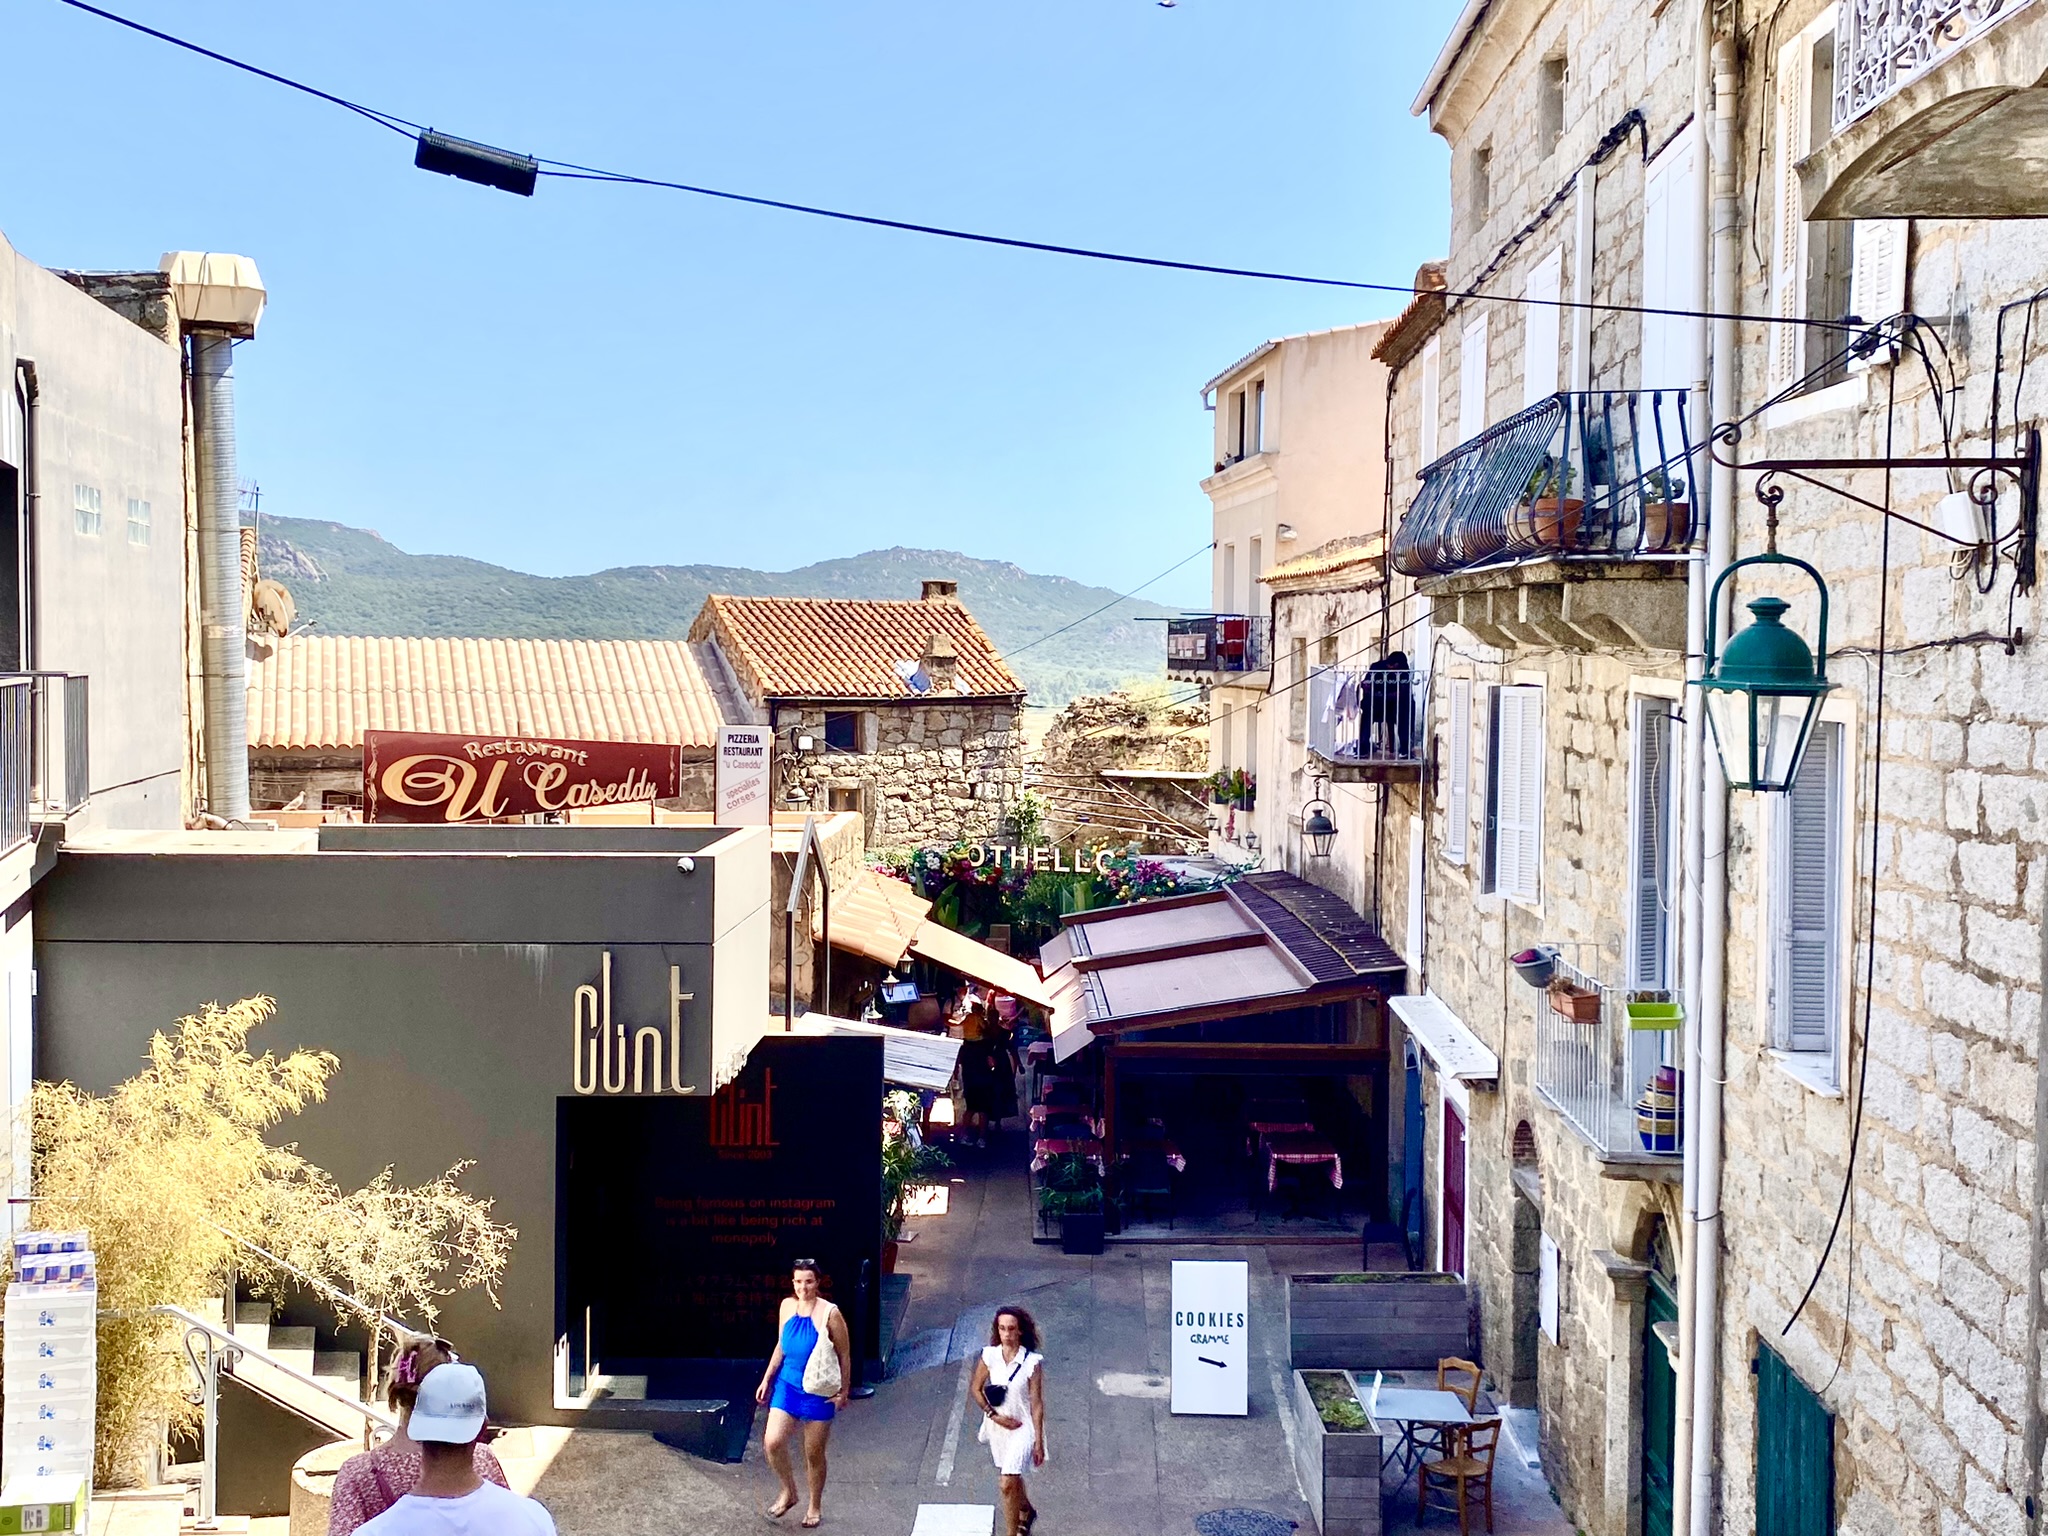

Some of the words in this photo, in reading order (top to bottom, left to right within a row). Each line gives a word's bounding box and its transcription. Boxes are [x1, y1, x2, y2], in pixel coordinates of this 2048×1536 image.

[727, 734, 760, 744] PIZZERIA
[723, 747, 763, 757] RESTAURANT
[524, 762, 658, 810] Caseddu
[726, 791, 756, 810] corses
[655, 1196, 692, 1211] Being
[696, 1195, 745, 1209] famous
[749, 1199, 766, 1208] on
[769, 1197, 836, 1211] instagram
[691, 1214, 709, 1226] bit
[713, 1213, 736, 1226] like
[740, 1213, 778, 1229] being
[782, 1213, 806, 1226] rich
[810, 1215, 824, 1226] at
[711, 1232, 778, 1247] monopoly
[1175, 1311, 1244, 1328] COOKIES
[1190, 1333, 1230, 1345] GRAMME
